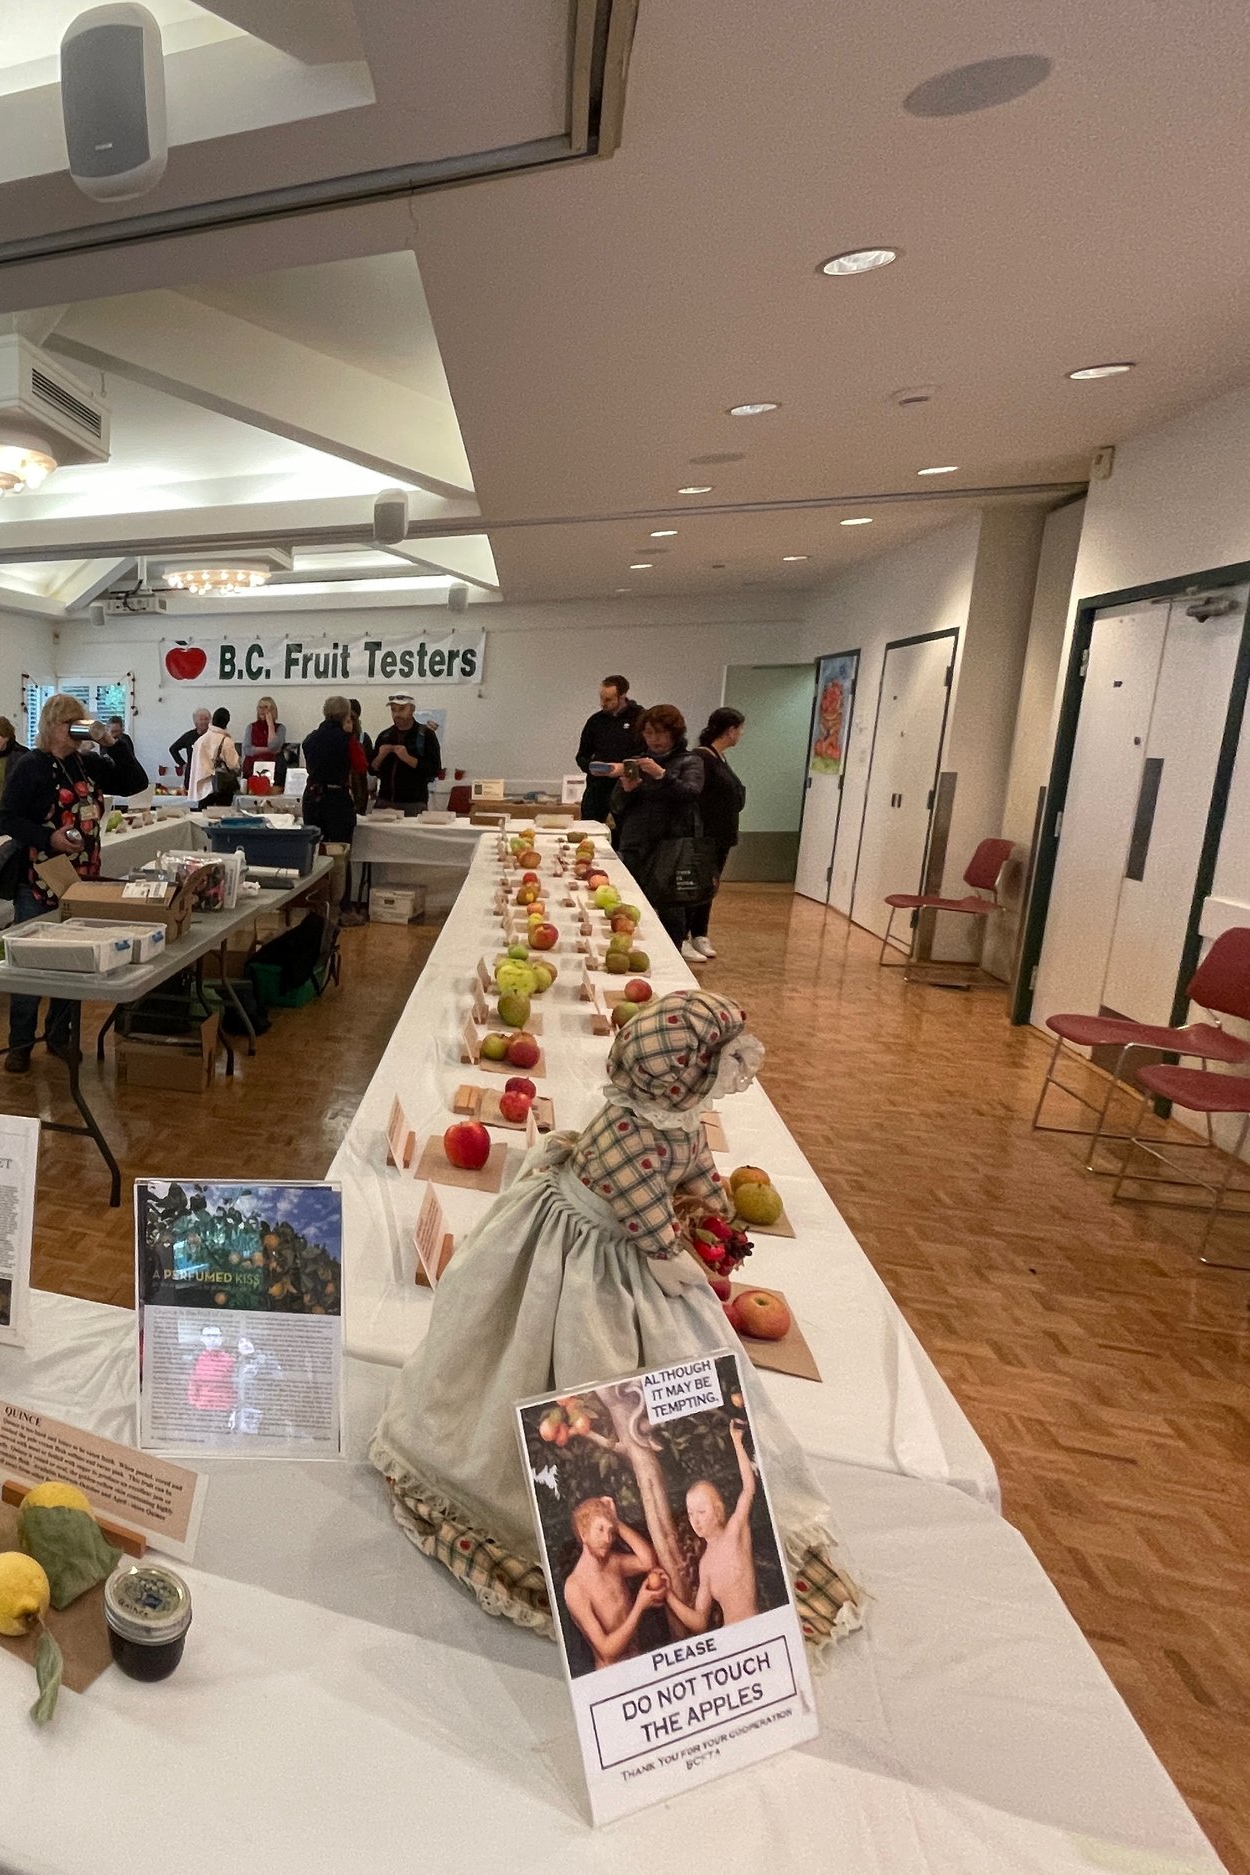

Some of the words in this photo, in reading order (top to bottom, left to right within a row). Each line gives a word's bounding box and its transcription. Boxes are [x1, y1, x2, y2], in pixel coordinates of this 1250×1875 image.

[219, 643, 271, 680] B.C.
[284, 642, 351, 679] Fruit
[364, 641, 478, 679] Testers
[152, 1270, 160, 1279] A
[163, 1269, 232, 1283] PERFUMED
[235, 1273, 260, 1285] KISS
[644, 1360, 711, 1387] ALTHOUGH
[652, 1388, 664, 1401] IT
[665, 1381, 692, 1398] MAY
[694, 1376, 712, 1390] BE
[4, 1406, 41, 1427] QUINCE
[651, 1392, 719, 1417] TEMPTING.
[652, 1638, 717, 1671] PLEASE
[622, 1694, 652, 1721] DO
[657, 1677, 697, 1708] NOT
[701, 1652, 771, 1690] TOUCH
[641, 1712, 683, 1742] THE
[688, 1683, 764, 1726] APPLES
[621, 1762, 655, 1783] THANK
[658, 1752, 680, 1767] YOU
[681, 1745, 700, 1759] FOR
[701, 1734, 728, 1749] YOUR
[729, 1709, 793, 1739] COOPERATION
